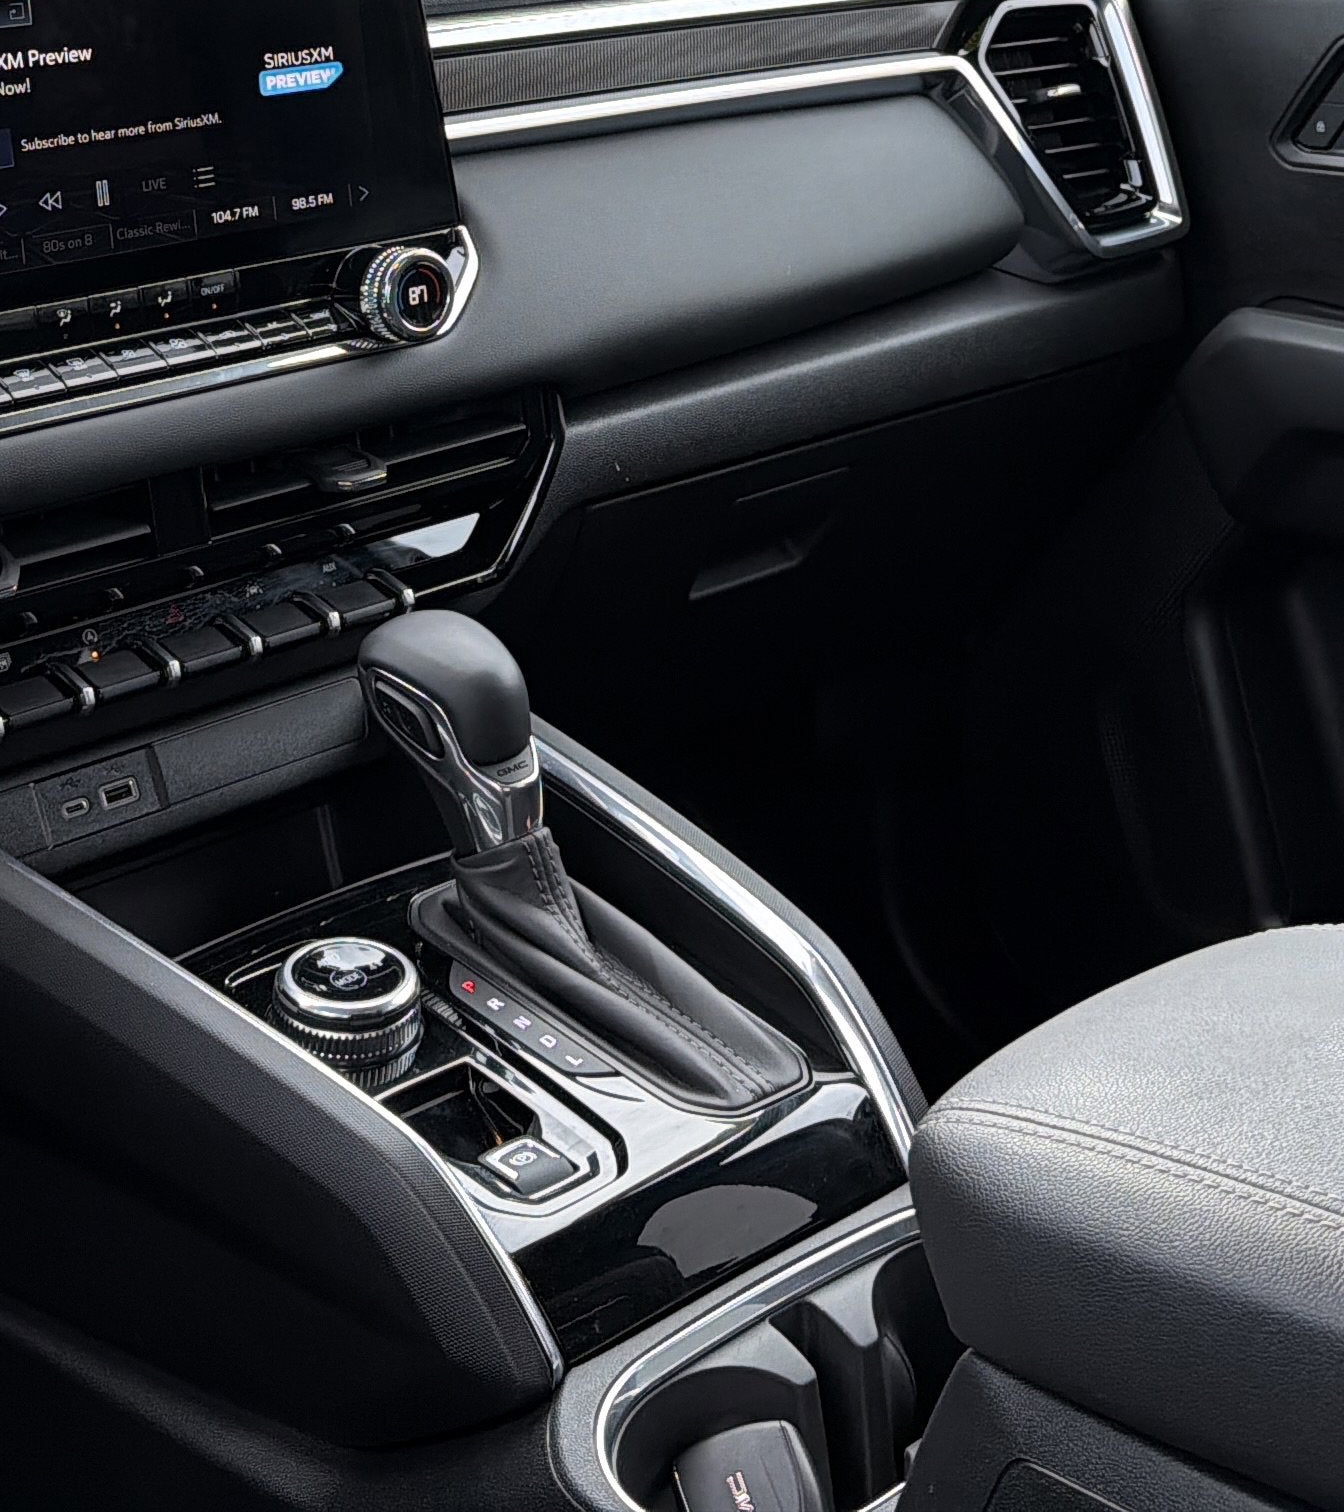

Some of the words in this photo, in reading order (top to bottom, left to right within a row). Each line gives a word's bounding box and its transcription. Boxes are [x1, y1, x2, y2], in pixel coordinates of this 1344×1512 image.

[27, 47, 93, 68] Preview
[263, 46, 334, 69] SIRIUSXM
[265, 69, 337, 91] PREVIEW
[20, 133, 75, 153] Subscribe
[77, 131, 90, 144] to
[91, 128, 116, 142] hear
[117, 125, 145, 138] more
[147, 121, 173, 134] from
[174, 113, 223, 129] SiriusXM.
[142, 178, 167, 193] LIVE
[291, 195, 316, 210] 98.5
[317, 193, 334, 206] FM
[210, 208, 241, 224] 104.7
[242, 206, 260, 219] FM
[116, 226, 154, 240] Classic
[68, 237, 83, 249] on
[408, 285, 428, 306] 87
[497, 759, 529, 778] GMC
[334, 971, 361, 986] MODE
[461, 980, 475, 993] P
[486, 998, 505, 1010] R
[513, 1015, 532, 1028] N
[539, 1035, 557, 1048] D
[565, 1054, 583, 1066] L
[725, 1471, 754, 1512] MC
